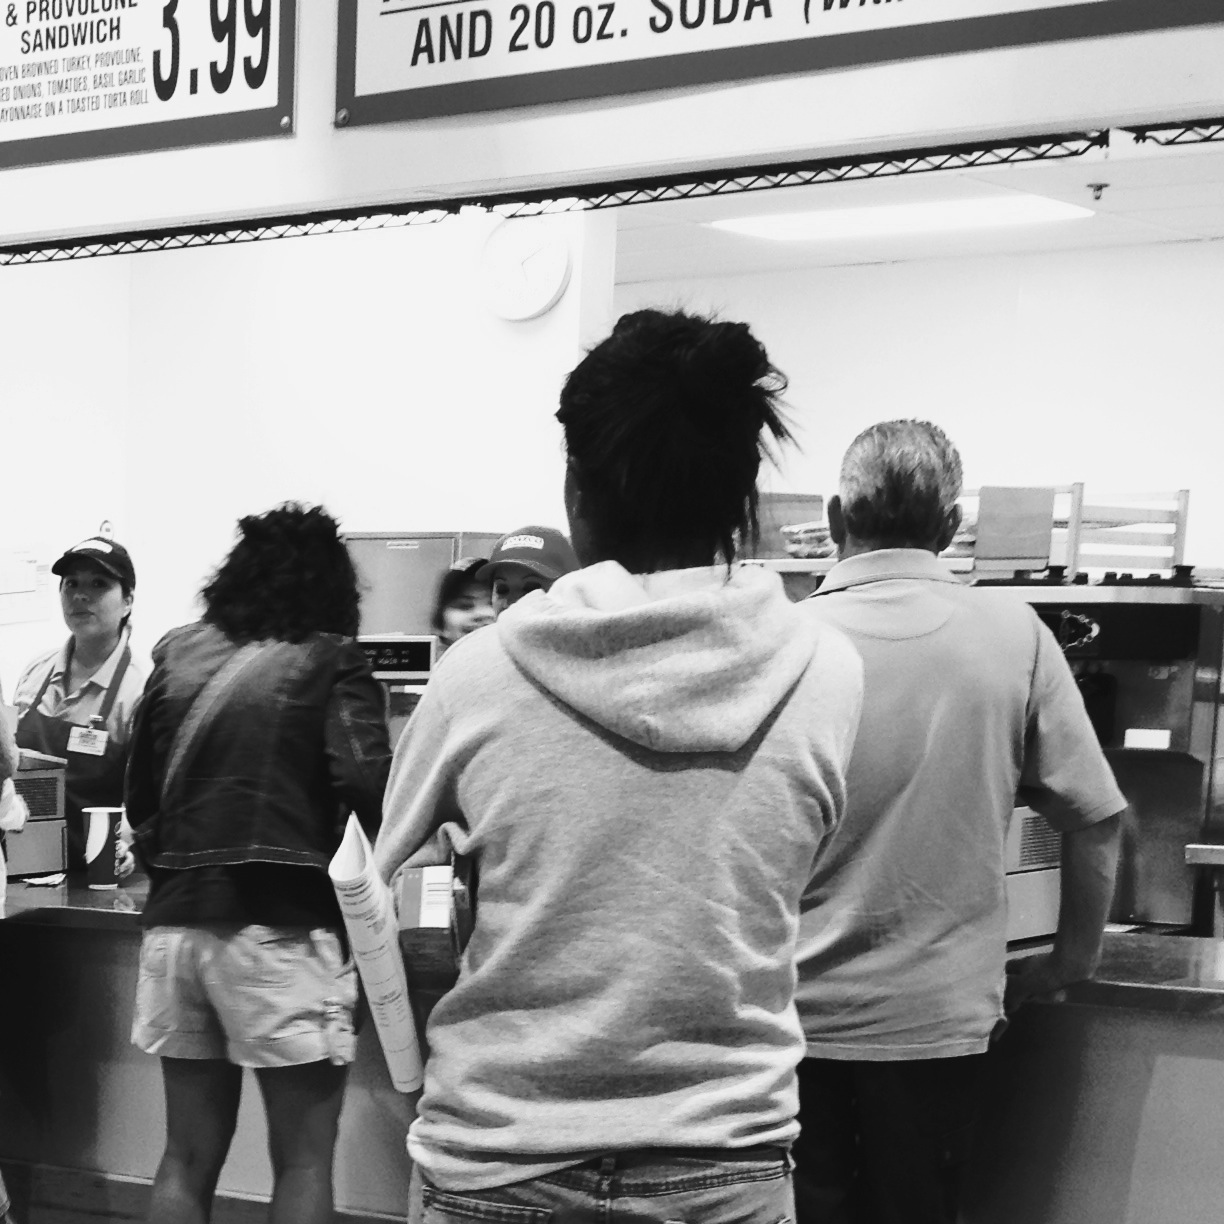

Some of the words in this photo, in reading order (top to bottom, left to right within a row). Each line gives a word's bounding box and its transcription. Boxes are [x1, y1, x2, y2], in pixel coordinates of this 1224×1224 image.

[5, 3, 18, 27] &
[21, 16, 121, 54] SANDWICH
[410, 9, 493, 67] AND
[509, 1, 556, 53] 20
[153, 0, 271, 101] 3.99
